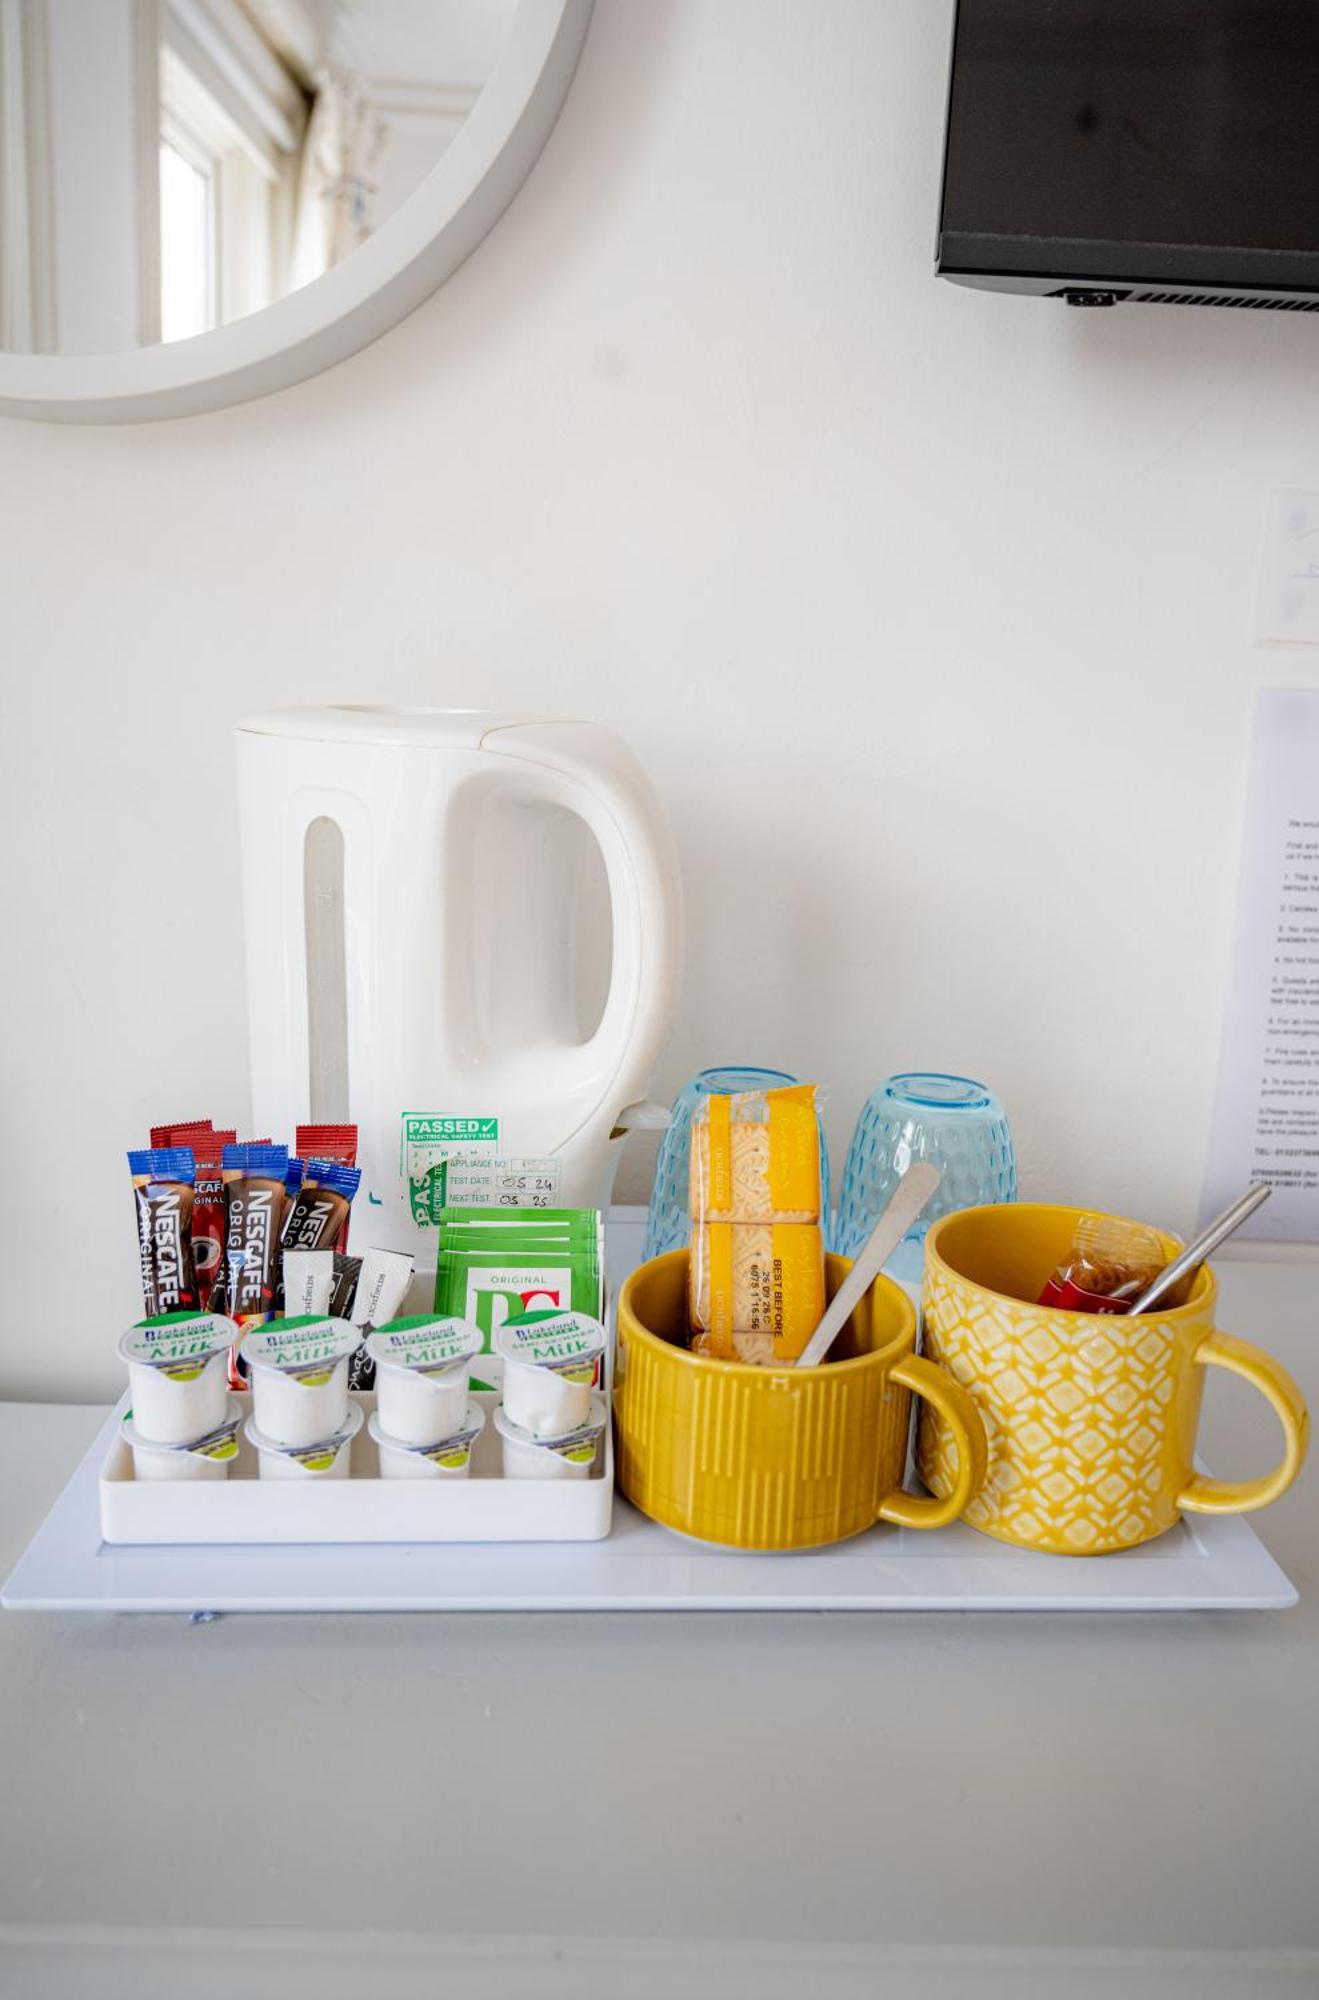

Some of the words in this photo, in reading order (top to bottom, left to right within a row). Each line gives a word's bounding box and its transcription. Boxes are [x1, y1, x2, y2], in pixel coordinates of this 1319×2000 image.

[408, 1120, 480, 1133] PASSED
[449, 1159, 492, 1169] APPLIANCE
[450, 1176, 468, 1186] TEST
[470, 1176, 491, 1186] DATE
[449, 1193, 468, 1202] NEXT
[471, 1193, 490, 1202] TEST
[490, 1275, 547, 1285] ORIGINAL
[772, 1258, 783, 1289] BEST
[774, 1291, 784, 1339] BEFORE
[150, 1341, 214, 1360] Milk
[275, 1345, 337, 1366] Milk
[404, 1344, 464, 1365] Milk
[533, 1340, 591, 1360] Milk
